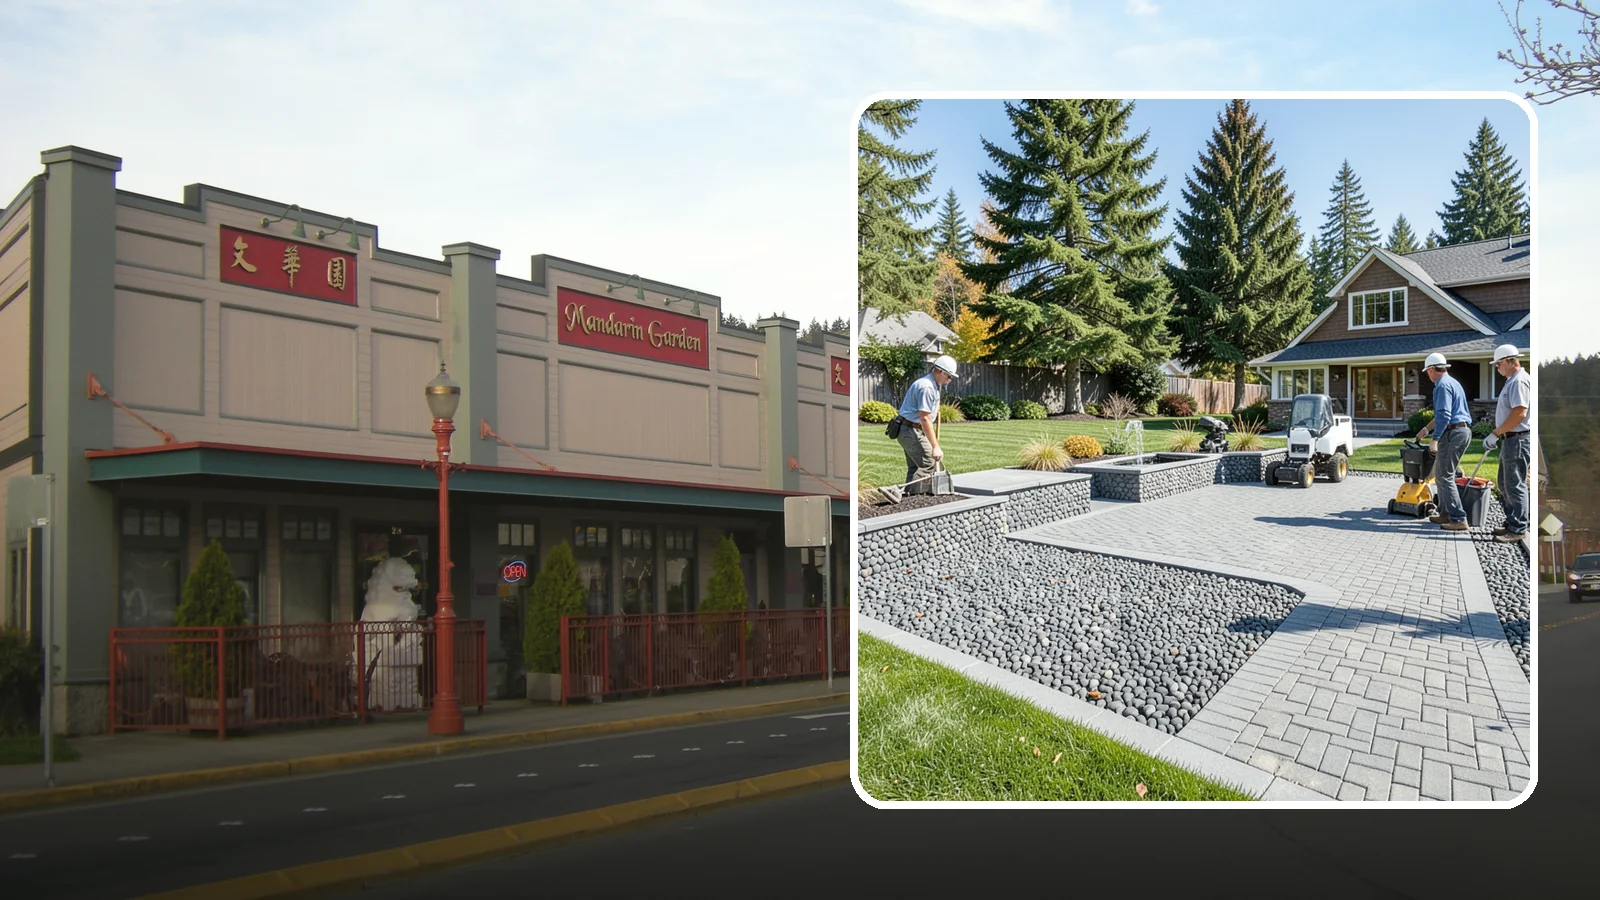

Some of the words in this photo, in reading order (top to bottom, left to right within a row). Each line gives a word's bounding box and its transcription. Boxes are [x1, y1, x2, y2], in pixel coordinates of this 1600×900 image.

[230, 235, 346, 291] 文華園
[564, 302, 644, 341] Mandarin
[647, 320, 701, 352] Garden
[503, 565, 527, 578] OPEN
